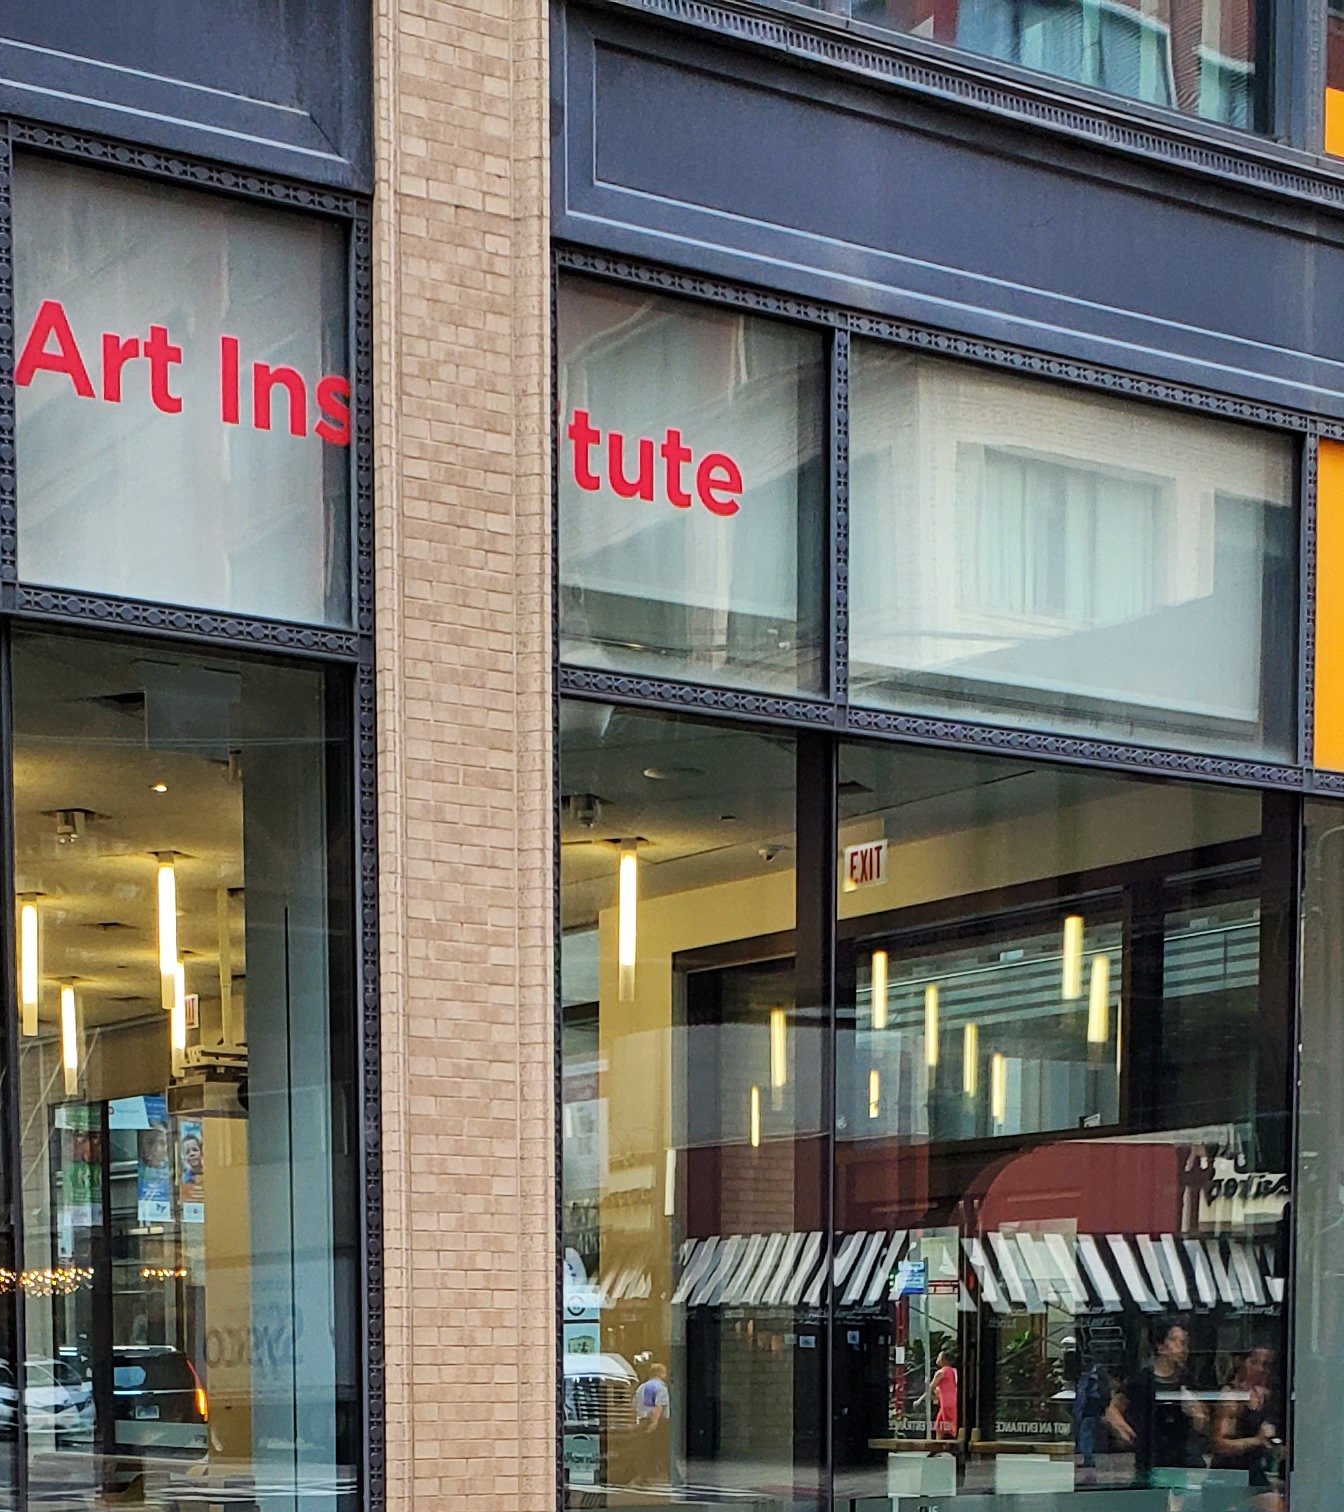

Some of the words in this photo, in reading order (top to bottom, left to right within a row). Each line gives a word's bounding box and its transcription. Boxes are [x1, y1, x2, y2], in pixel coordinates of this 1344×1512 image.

[16, 299, 184, 414] Art
[559, 404, 744, 517] tute
[850, 845, 883, 884] EXIT
